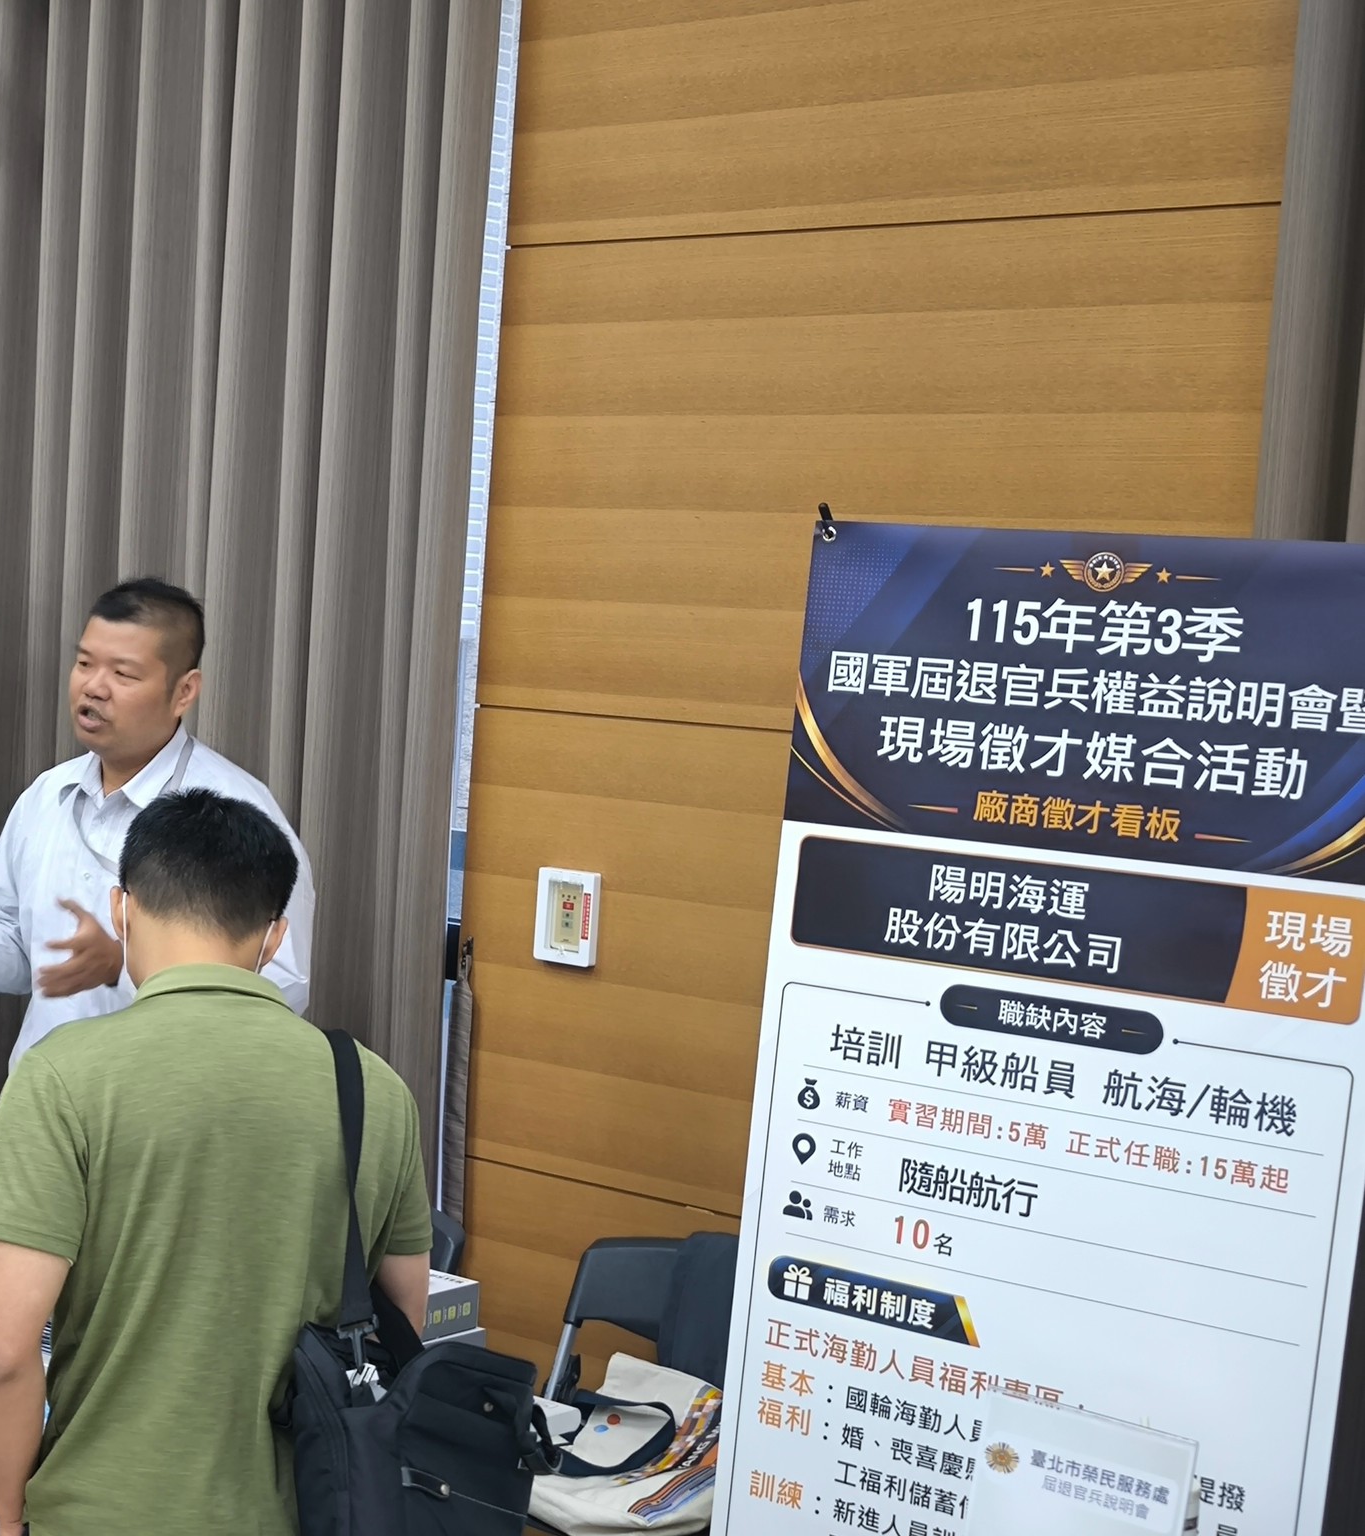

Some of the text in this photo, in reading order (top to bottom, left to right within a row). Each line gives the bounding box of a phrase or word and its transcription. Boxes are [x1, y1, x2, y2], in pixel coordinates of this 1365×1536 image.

[966, 597, 1245, 663] 115年第3季
[877, 715, 1309, 800] 現場徵才媒合活動
[973, 790, 1181, 843] 廠商徵才看板
[928, 863, 1090, 920] 陽明海運
[883, 906, 1122, 974] 股份有限公司
[1264, 910, 1354, 957] 現場
[1257, 959, 1348, 1008] 徵才
[997, 998, 1108, 1041] 職缺內容
[830, 1023, 1298, 1138] 培訓 甲級船員 航海/輪機
[834, 1090, 869, 1114] 薪資
[827, 1159, 862, 1182] 地點
[830, 1138, 864, 1160] 工作
[898, 1157, 1039, 1219] 隨船航行
[823, 1204, 857, 1228] 需求
[822, 1276, 937, 1331] 福利制度
[834, 1459, 969, 1520] 工福利儲蓄
[1029, 1449, 1171, 1505] 臺北市榮民服務處
